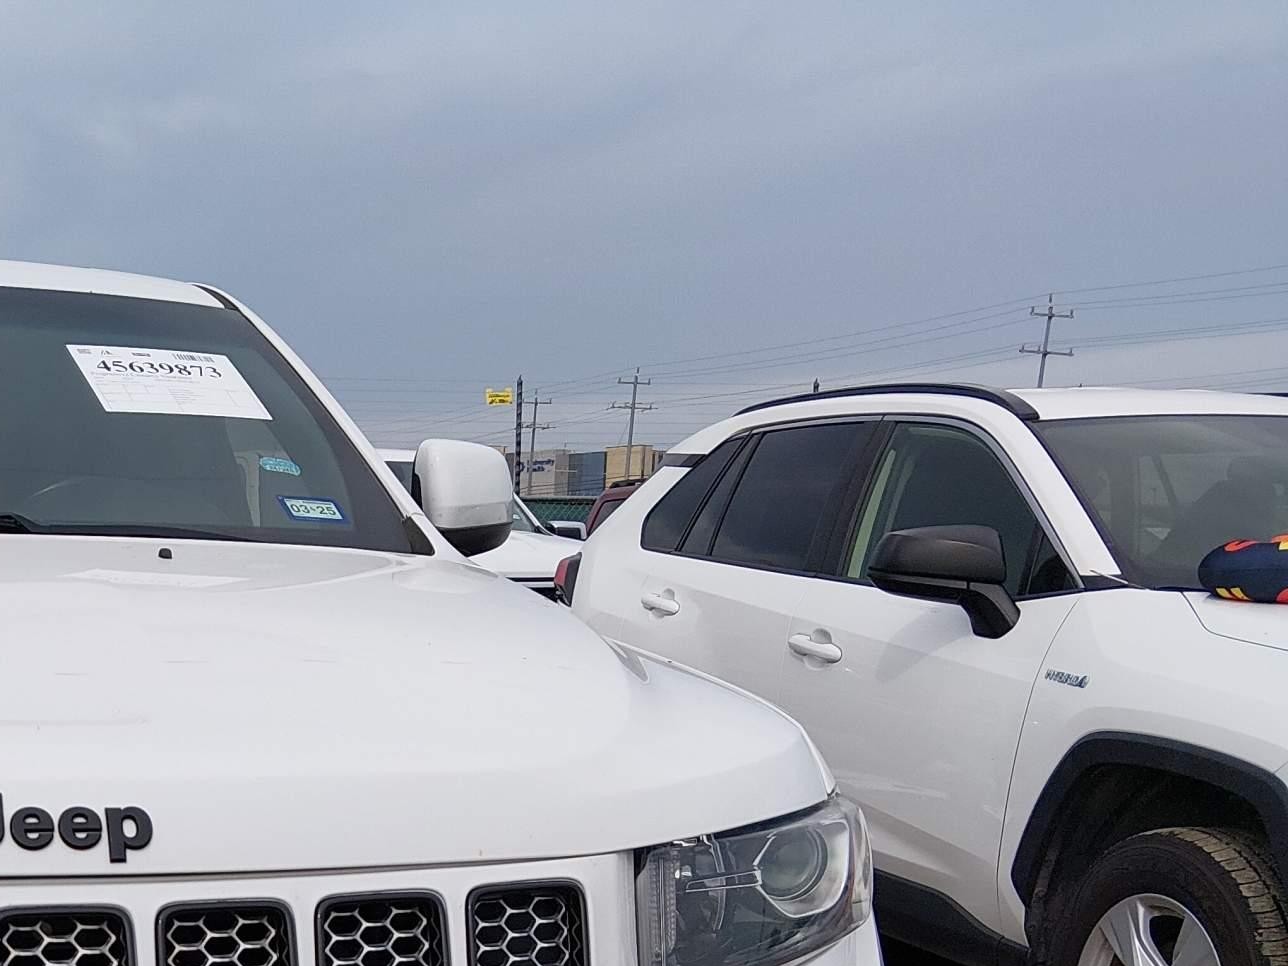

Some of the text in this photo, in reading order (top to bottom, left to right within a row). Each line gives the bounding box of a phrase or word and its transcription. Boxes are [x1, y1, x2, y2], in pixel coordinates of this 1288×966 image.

[96, 359, 223, 379] 45639873
[290, 503, 337, 516] 03 25
